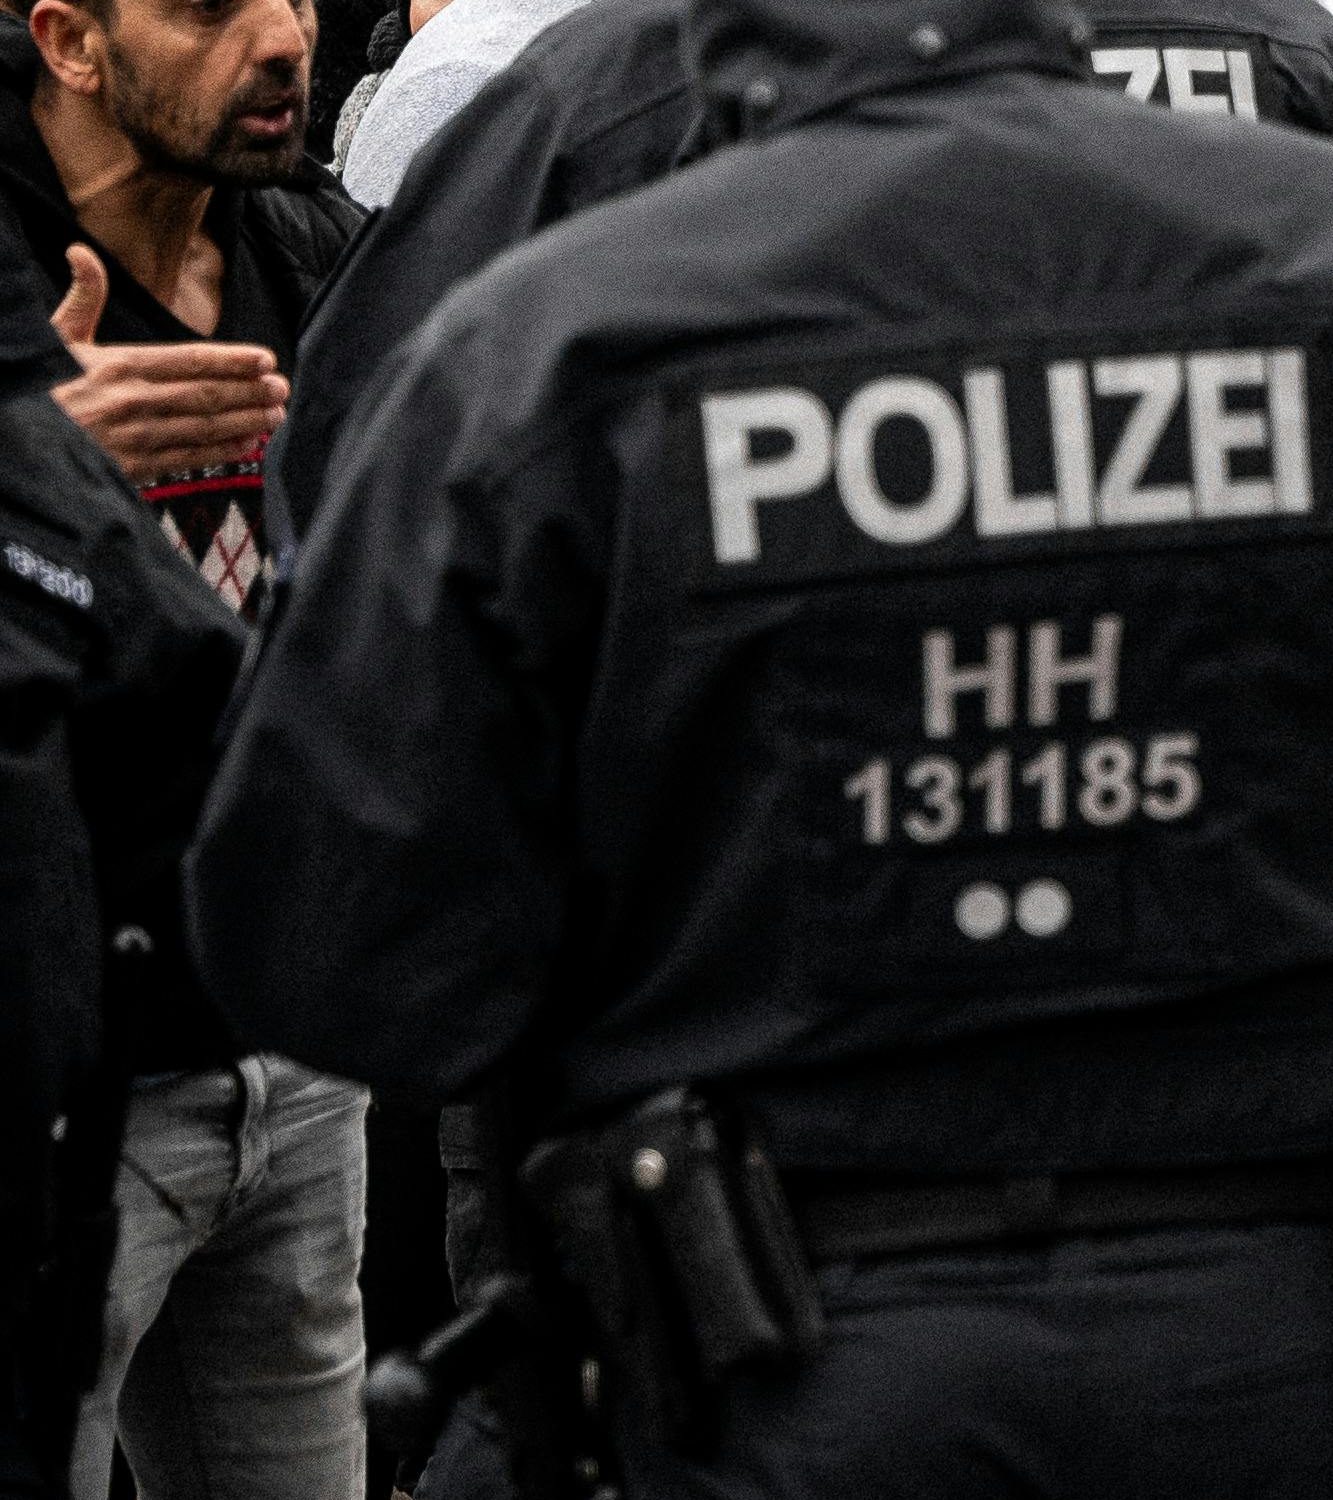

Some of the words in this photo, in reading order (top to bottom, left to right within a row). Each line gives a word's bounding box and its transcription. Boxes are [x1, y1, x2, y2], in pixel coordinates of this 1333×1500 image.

[700, 348, 1314, 565] POLIZEI
[921, 614, 1124, 738] HH
[843, 732, 1203, 845] 131185
